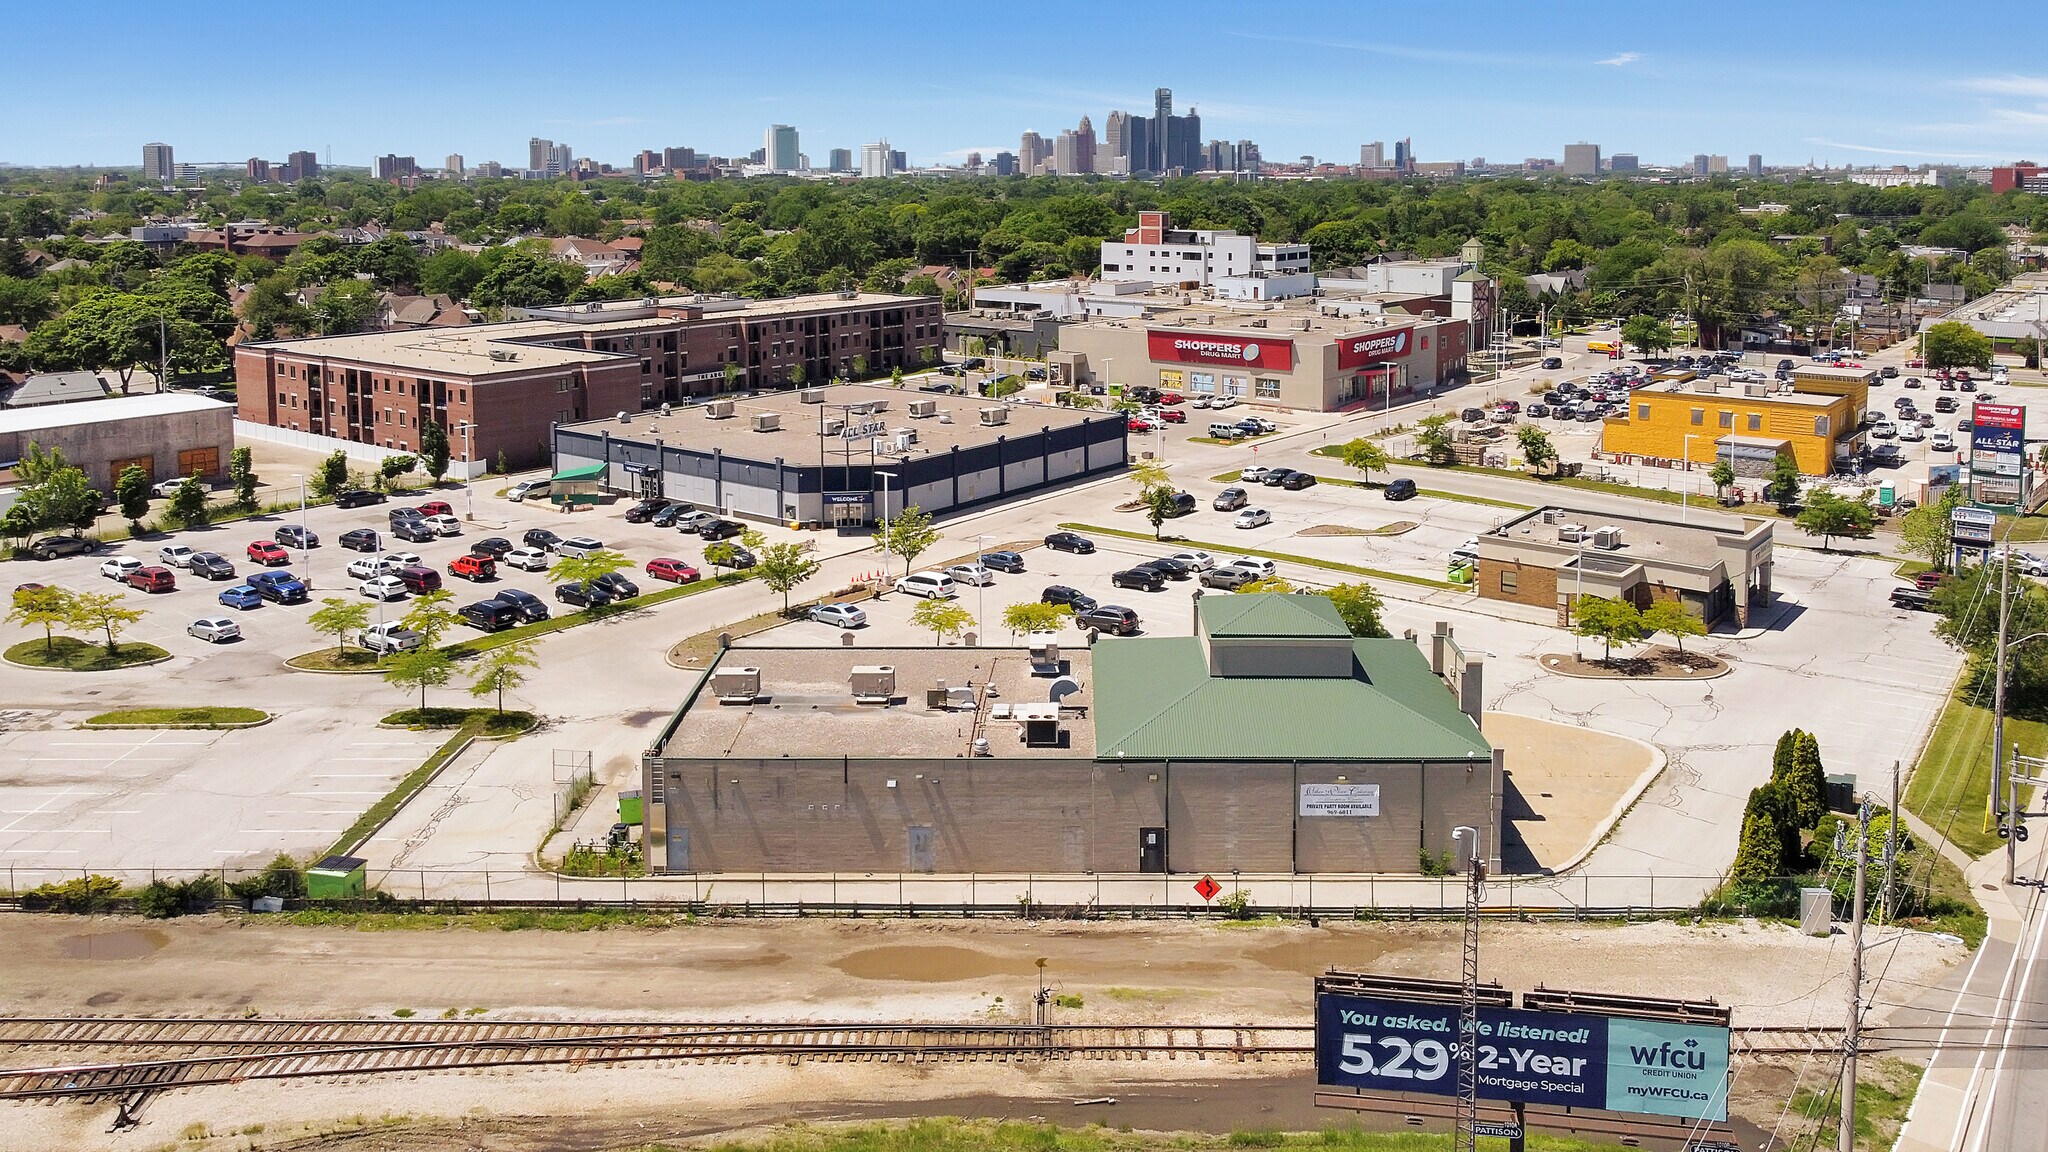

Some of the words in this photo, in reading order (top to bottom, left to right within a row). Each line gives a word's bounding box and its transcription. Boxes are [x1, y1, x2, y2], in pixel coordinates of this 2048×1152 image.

[1174, 339, 1241, 353] SHOPPERS
[1353, 336, 1396, 353] SHOPPERS
[1368, 349, 1381, 357] DRUG
[1381, 346, 1394, 354] MART
[1200, 350, 1220, 358] DRUG
[840, 426, 859, 438] ALL
[862, 421, 886, 435] STAR
[1974, 437, 1993, 445] ALL
[1995, 438, 2020, 448] STAR
[1340, 1009, 1378, 1026] You
[1383, 1014, 1451, 1033] asked.
[1458, 1019, 1493, 1036] We
[1496, 1021, 1590, 1044] listened!
[1477, 1045, 1587, 1077] 2-Year
[1629, 1041, 1706, 1071] wfcu
[1642, 1068, 1671, 1078] CREDIT
[1671, 1071, 1698, 1080] UNION
[1478, 1074, 1539, 1091] Mortgage
[1540, 1080, 1585, 1094] Special
[1627, 1086, 1709, 1101] myWFCU.ca
[1475, 1126, 1518, 1137] PATTISON
